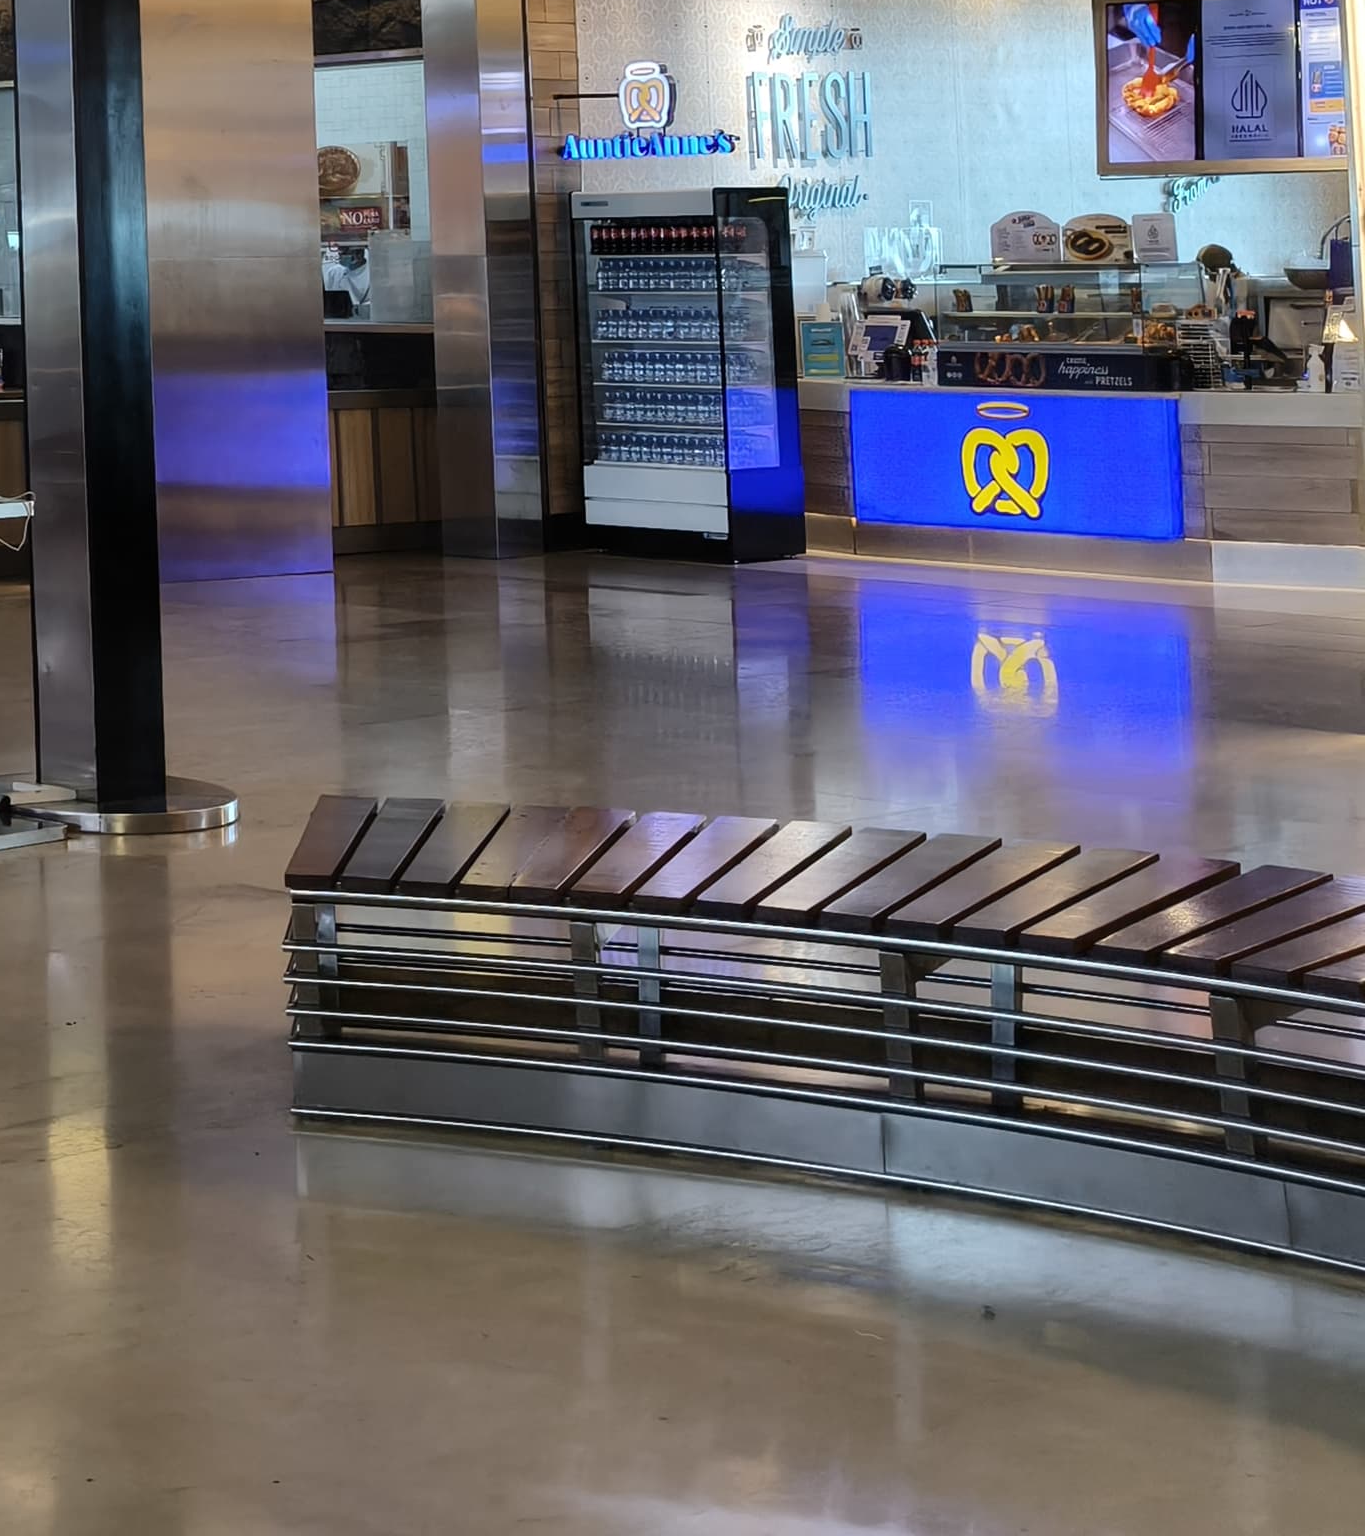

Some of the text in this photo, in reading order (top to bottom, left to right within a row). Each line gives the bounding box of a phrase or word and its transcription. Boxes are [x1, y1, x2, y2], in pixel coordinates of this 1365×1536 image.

[771, 14, 846, 60] Simple
[751, 70, 873, 161] FRESH
[1231, 124, 1269, 134] HALAL
[562, 130, 736, 161] Auntie Anne's
[340, 211, 363, 225] NO
